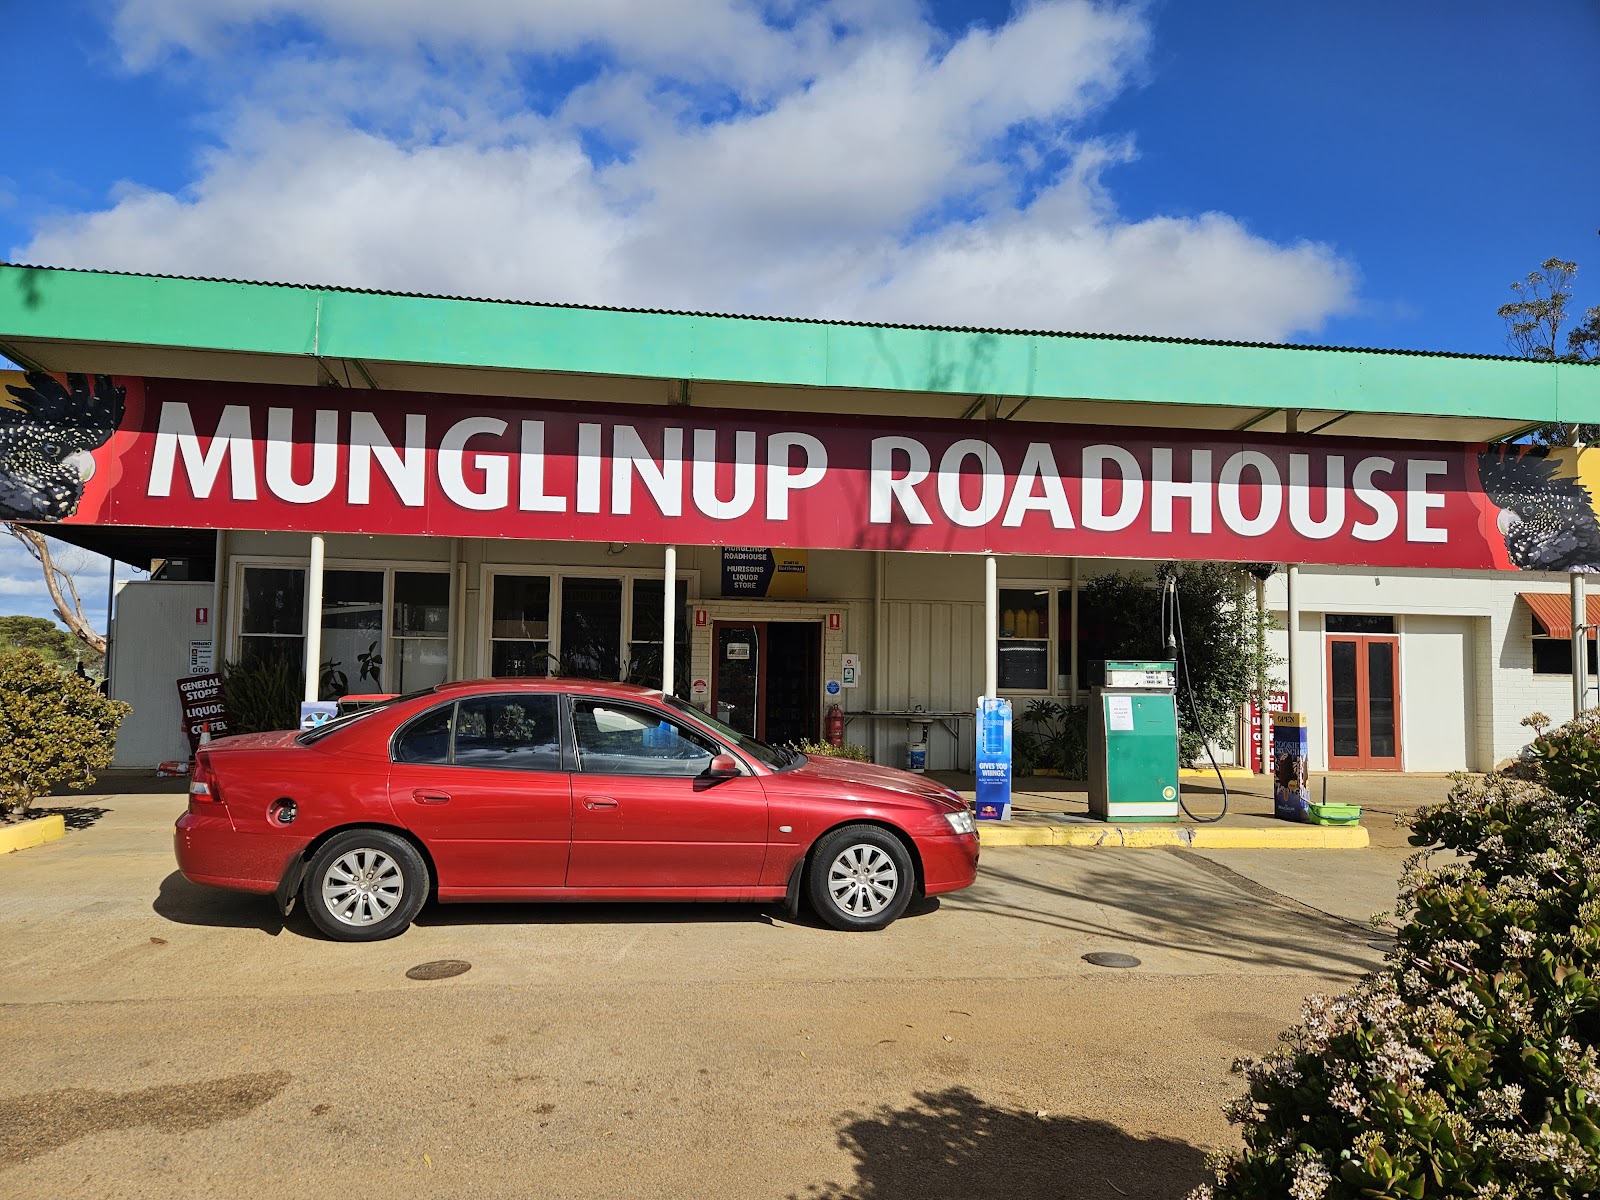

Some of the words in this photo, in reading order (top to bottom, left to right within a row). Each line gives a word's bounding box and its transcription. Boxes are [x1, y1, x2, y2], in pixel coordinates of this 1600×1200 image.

[147, 401, 828, 522] MUNGLINUP
[869, 435, 1449, 544] ROADHOUSE
[724, 552, 767, 561] ROADHOUSE
[732, 574, 758, 582] LIQUOR
[180, 678, 222, 691] GENERAL
[1277, 715, 1295, 723] OPEN
[979, 762, 995, 770] GIVES
[995, 762, 1008, 771] YOU
